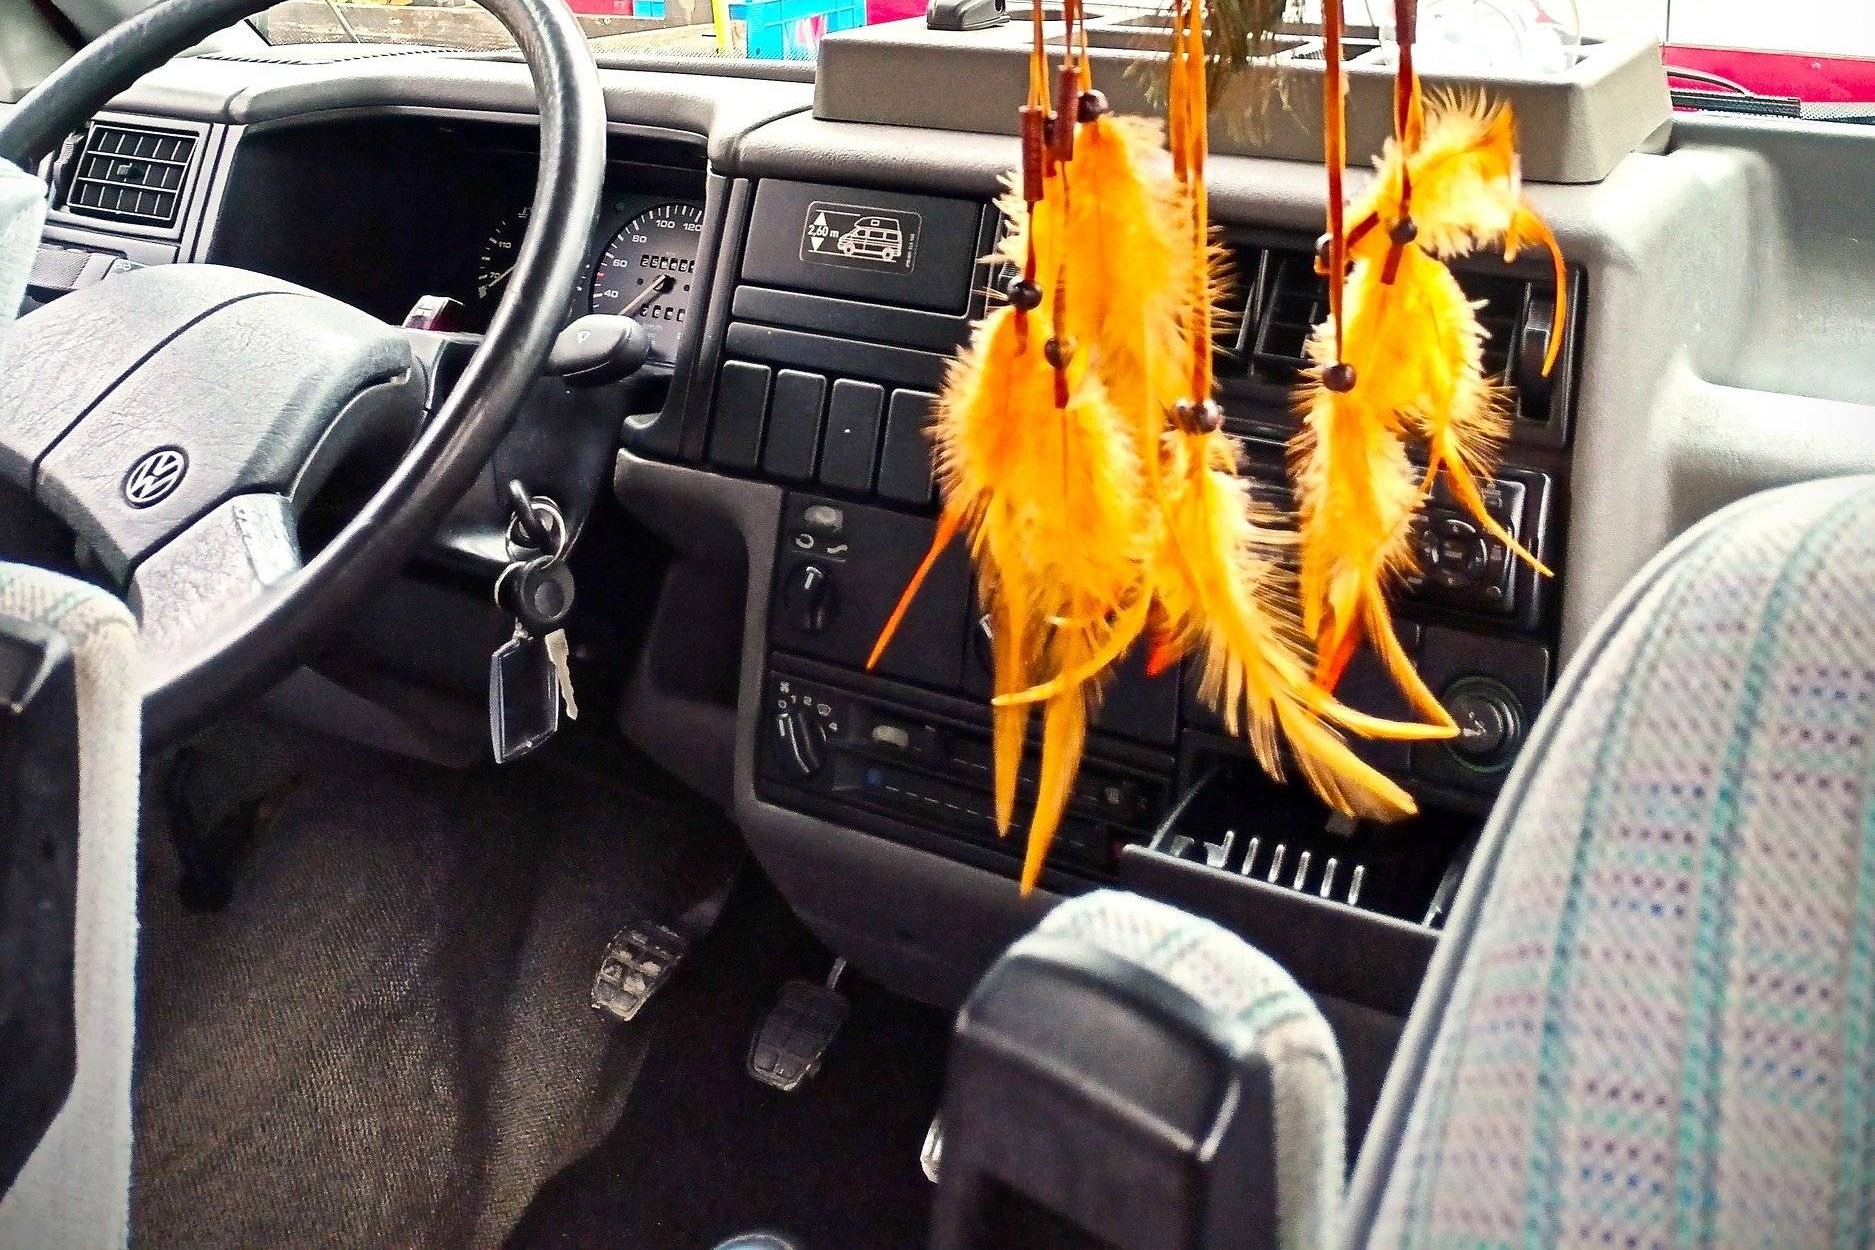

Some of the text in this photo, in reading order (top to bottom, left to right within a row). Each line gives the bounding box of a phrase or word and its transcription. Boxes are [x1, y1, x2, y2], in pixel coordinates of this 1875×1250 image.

[655, 219, 676, 229] 100
[682, 221, 702, 232] 120
[808, 224, 839, 238] 2,60 m
[632, 234, 648, 243] 80
[612, 258, 628, 268] 60
[603, 289, 619, 299] 40
